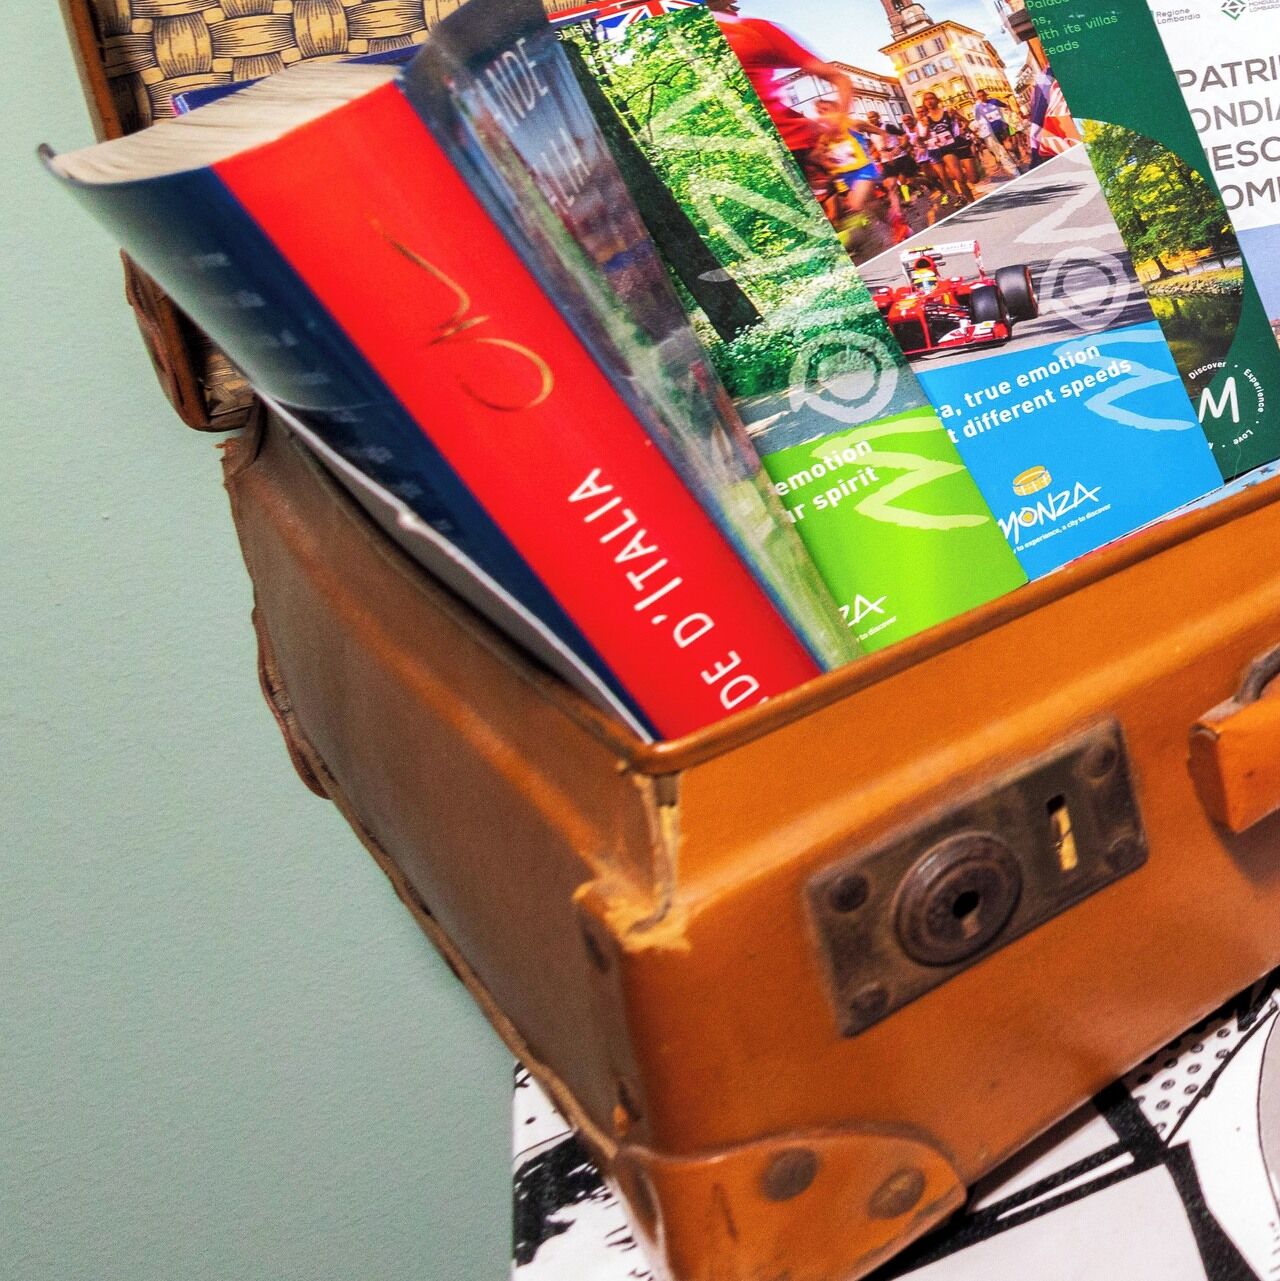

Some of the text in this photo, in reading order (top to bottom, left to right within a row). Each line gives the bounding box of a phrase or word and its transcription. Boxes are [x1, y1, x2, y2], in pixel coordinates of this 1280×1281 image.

[1064, 12, 1118, 35] its villas
[1156, 6, 1190, 18] Regione
[1157, 11, 1201, 26] Lombardia
[964, 344, 1102, 412] true emotion
[1187, 360, 1228, 381] Discover
[1242, 367, 1267, 415] Experience
[963, 358, 1132, 440] different speeds
[1231, 427, 1254, 446] Love
[775, 439, 874, 498] emotion
[814, 466, 880, 512] spirit
[567, 466, 768, 709] DE D'ITALIA
